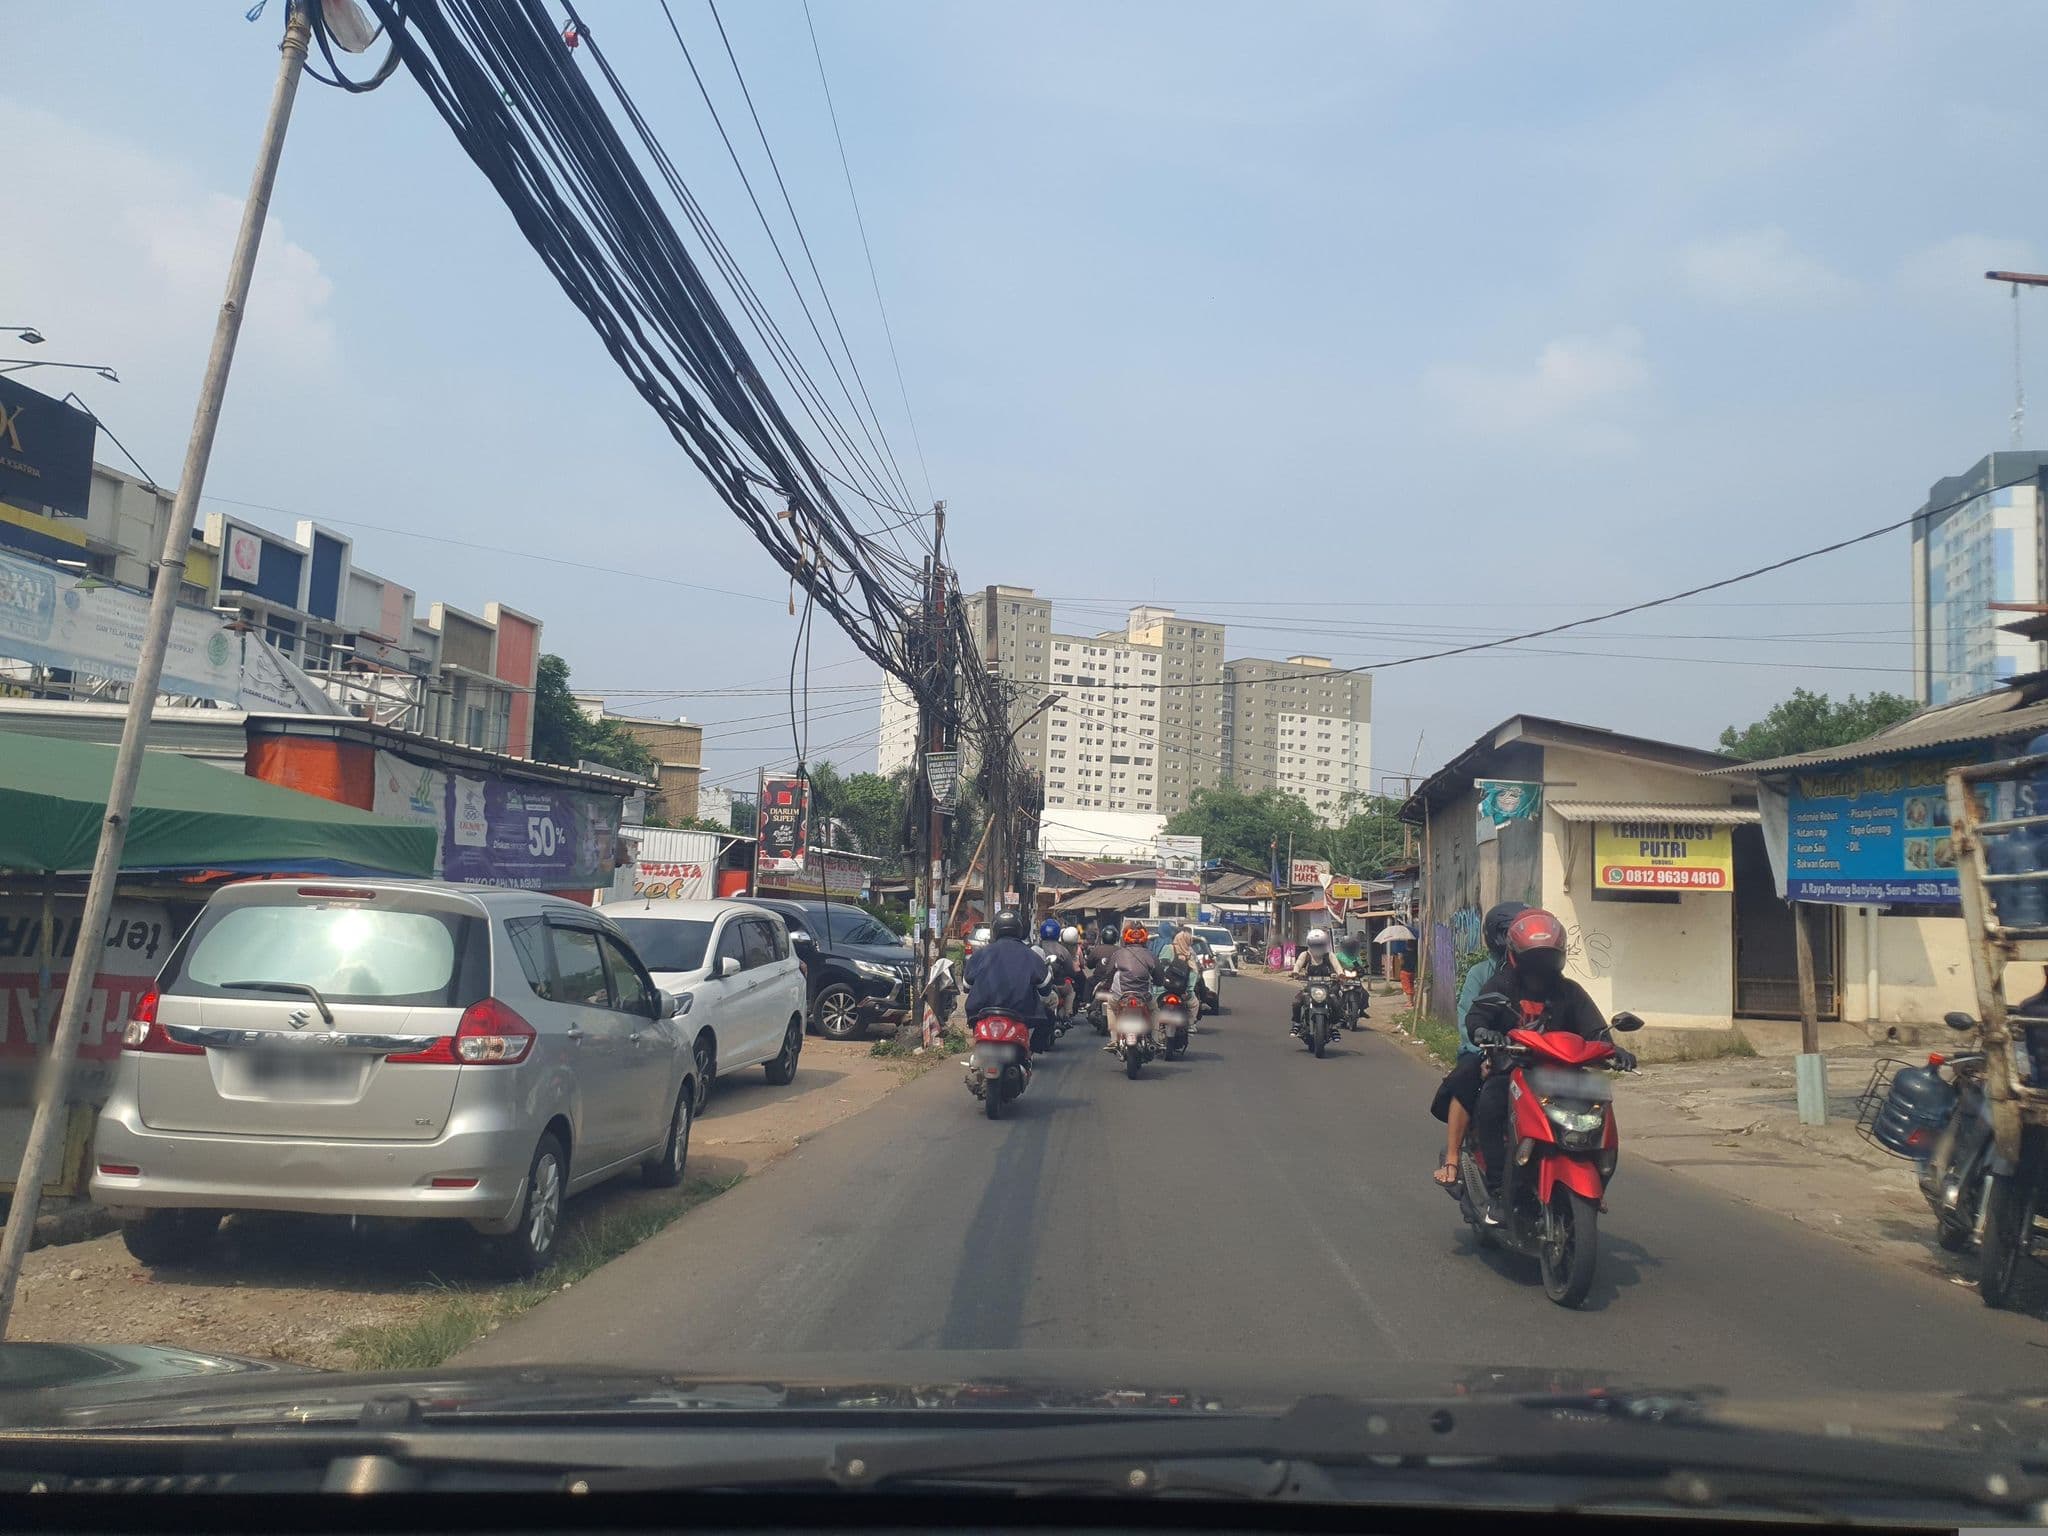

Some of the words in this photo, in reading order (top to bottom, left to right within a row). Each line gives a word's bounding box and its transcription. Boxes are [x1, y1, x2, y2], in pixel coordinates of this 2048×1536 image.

[72, 657, 109, 678] AGEN
[1611, 822, 1671, 840] TERIMA
[1673, 823, 1714, 841] KOST
[1639, 840, 1687, 859] PUTRI
[640, 863, 703, 878] WIJAYA
[1626, 870, 1655, 883] 0812
[1657, 871, 1689, 884] 9639
[1691, 871, 1720, 885] 4810
[1809, 883, 1825, 897] Raya
[1825, 884, 1851, 898] Parung
